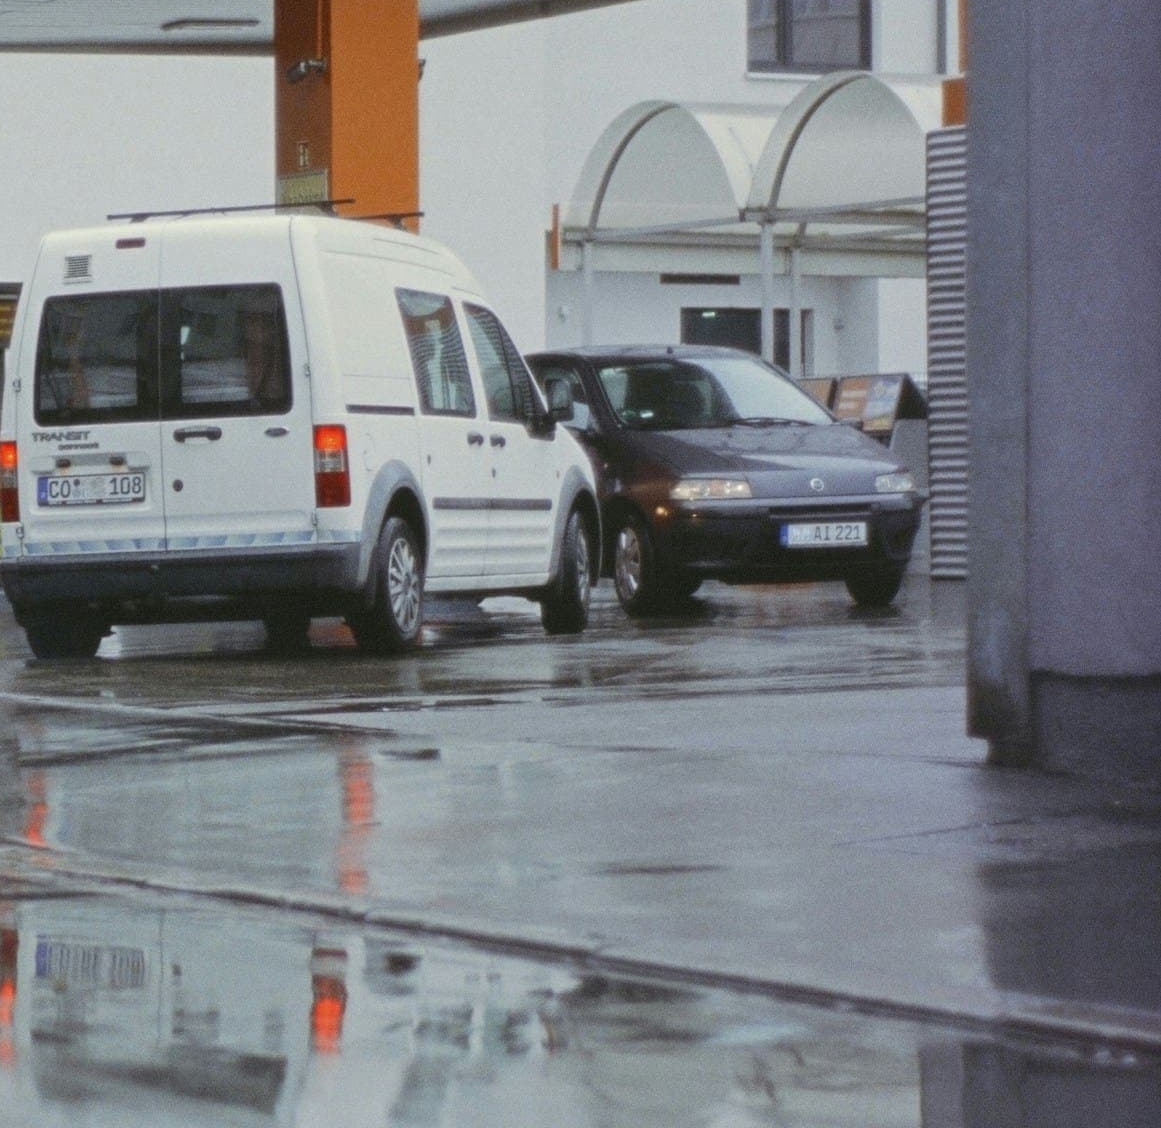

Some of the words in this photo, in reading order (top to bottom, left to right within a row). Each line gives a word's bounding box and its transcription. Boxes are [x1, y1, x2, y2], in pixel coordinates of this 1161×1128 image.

[32, 431, 91, 442] TRANSIT
[109, 476, 142, 495] 108
[814, 525, 831, 541] AI
[835, 524, 861, 541] 221
